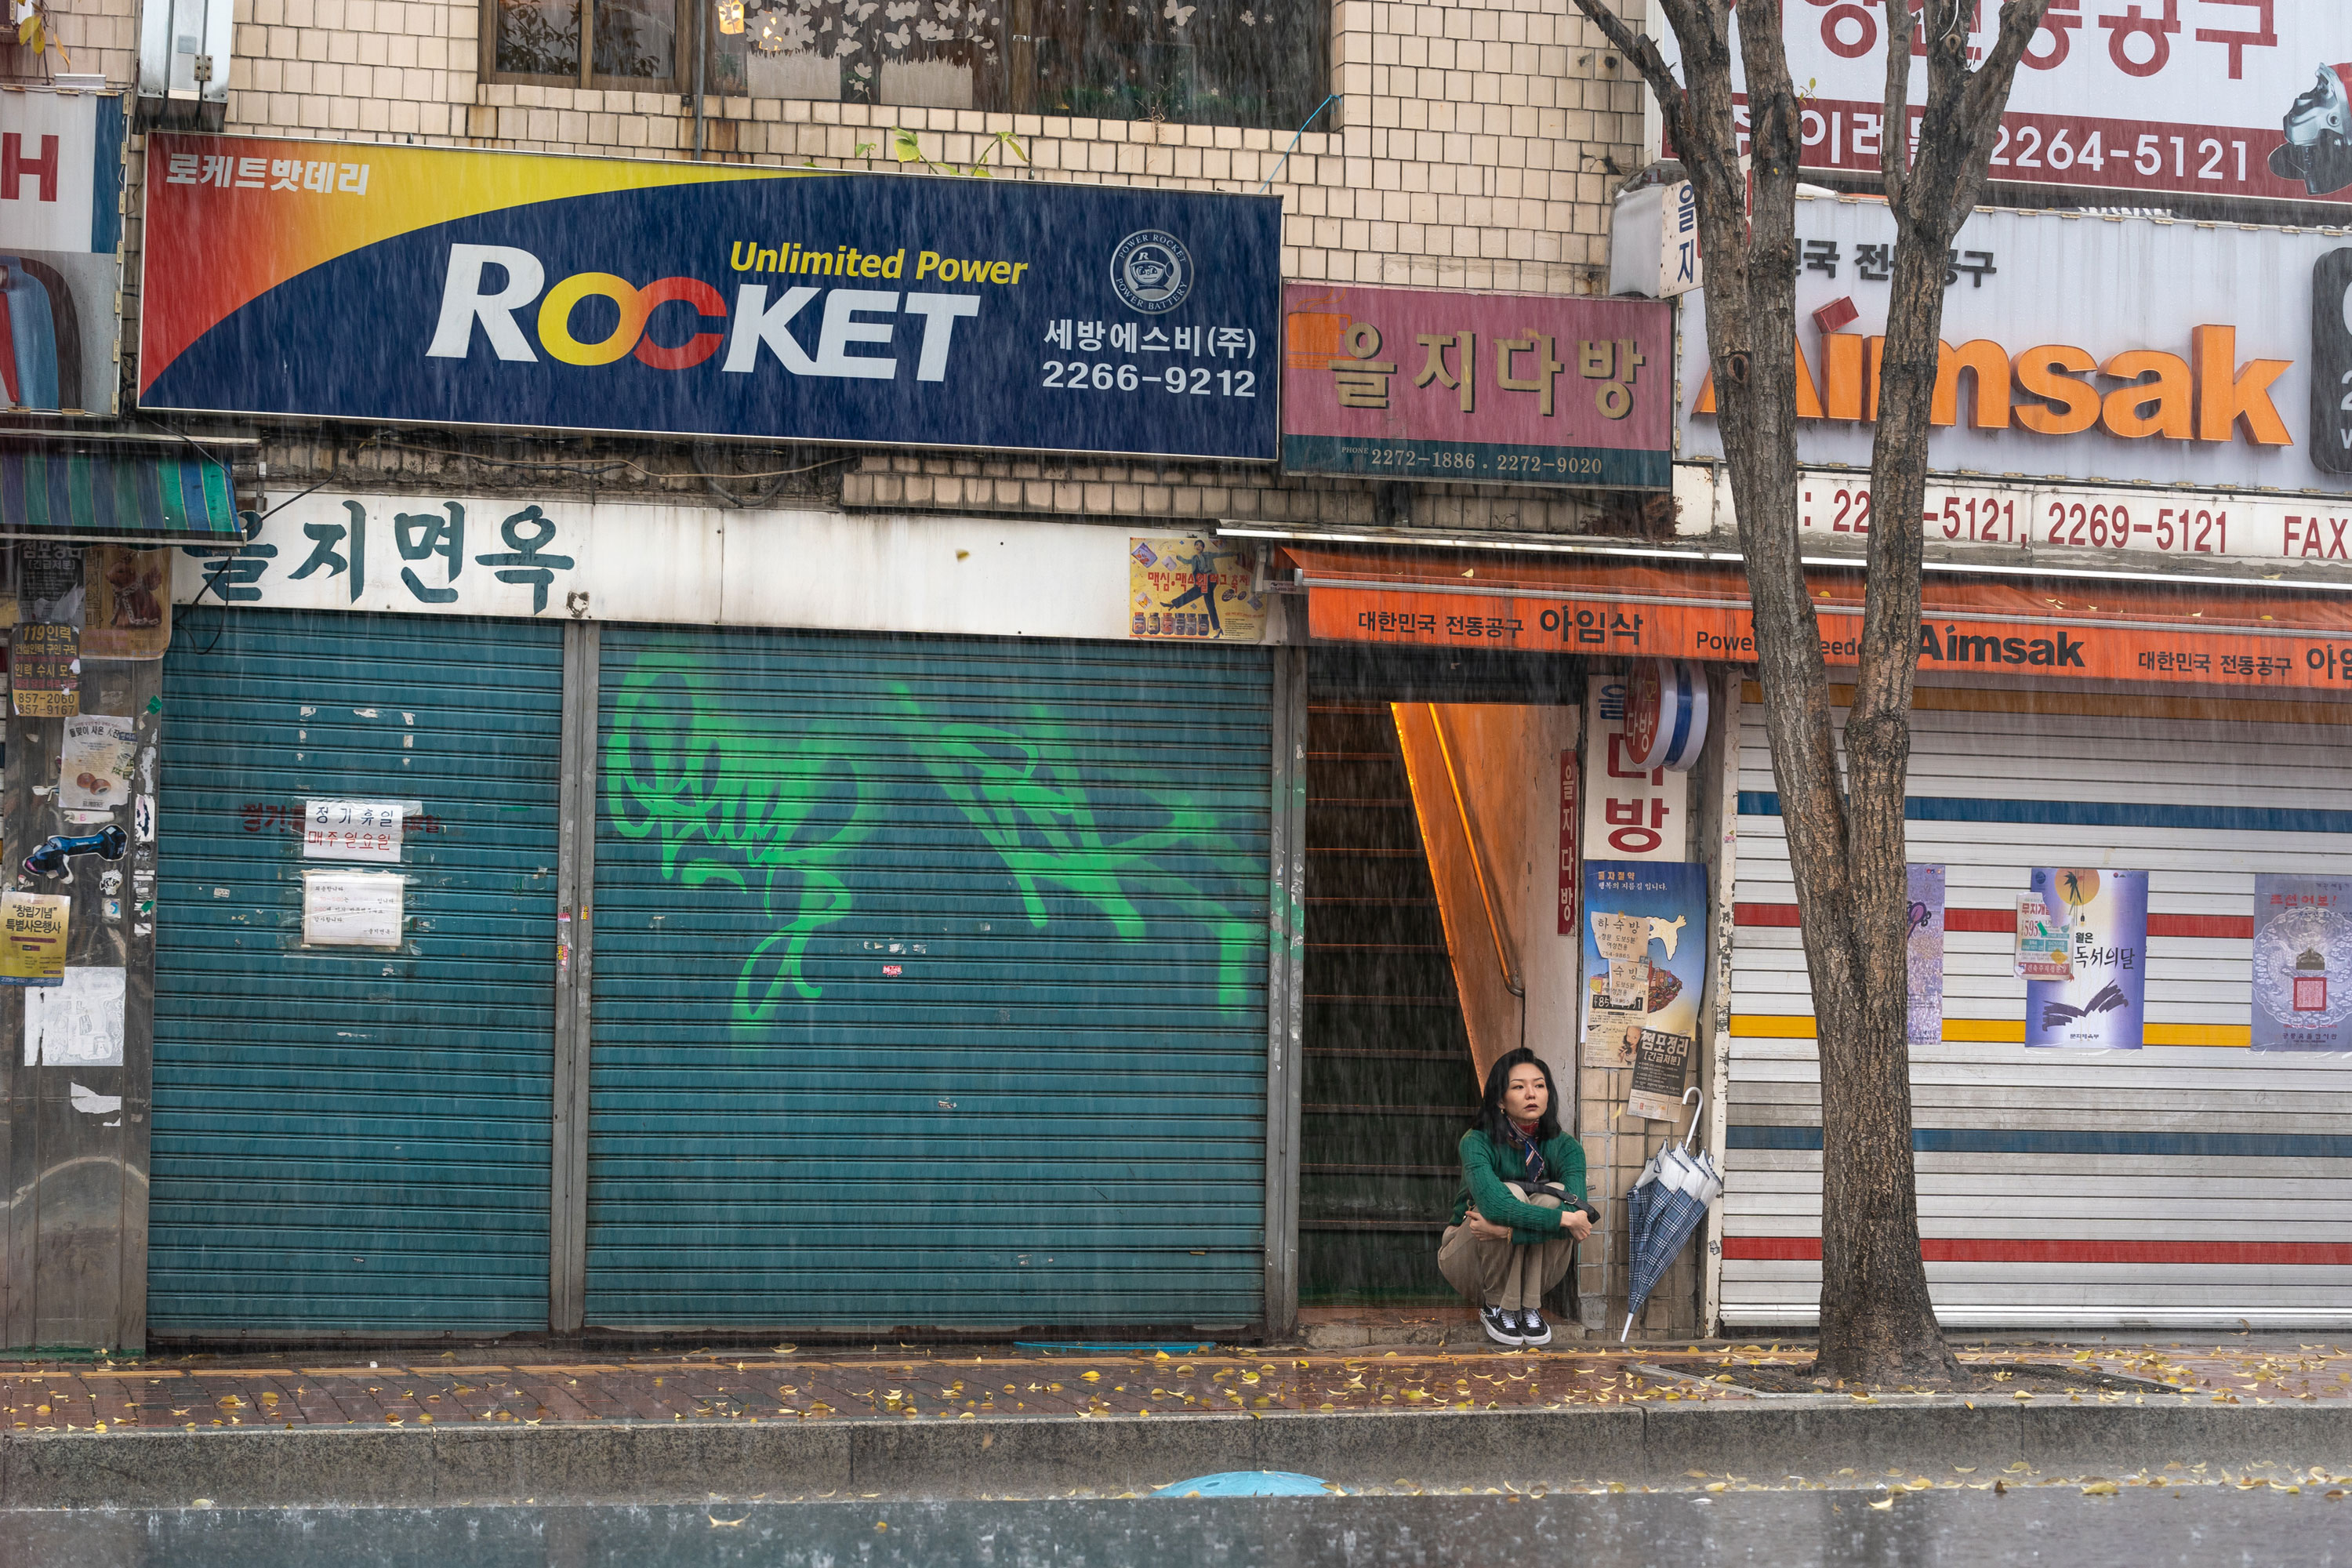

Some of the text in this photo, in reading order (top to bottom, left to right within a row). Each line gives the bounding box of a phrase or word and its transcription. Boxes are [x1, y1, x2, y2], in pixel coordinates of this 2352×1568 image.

[1990, 125, 2249, 183] 2264-5121
[165, 153, 370, 196] 로케트밧데리
[730, 240, 1029, 285] Unlimited Power
[1118, 234, 1187, 263] POWER ROCKET
[1116, 278, 1188, 310] POWER BATTERY
[425, 243, 981, 383] ROCKET
[1044, 319, 1256, 359] 세방에스비(주)
[1042, 361, 1255, 397] 2266-9212
[1341, 446, 1602, 475] PHONE 2272-1886 2272-9020
[1832, 488, 2349, 559] 22-5121, 2269-5121 FAX
[182, 499, 575, 617] 을지면옥
[1358, 604, 1644, 646] 대한민국 전동공구 아임삭
[46, 644, 62, 655] 구인
[63, 644, 77, 656] 구직
[1918, 624, 2085, 668] Aimsak
[2138, 651, 2212, 673] 대한민국
[2220, 653, 2293, 677] 전동공구
[15, 664, 32, 677] 인력
[37, 664, 55, 678] 수시
[18, 693, 74, 704] 857-2060
[19, 704, 75, 715] 857-9167
[307, 830, 391, 851] 매주 일요일
[1560, 764, 1574, 921] 을지다방
[1598, 881, 1620, 891] 행복의
